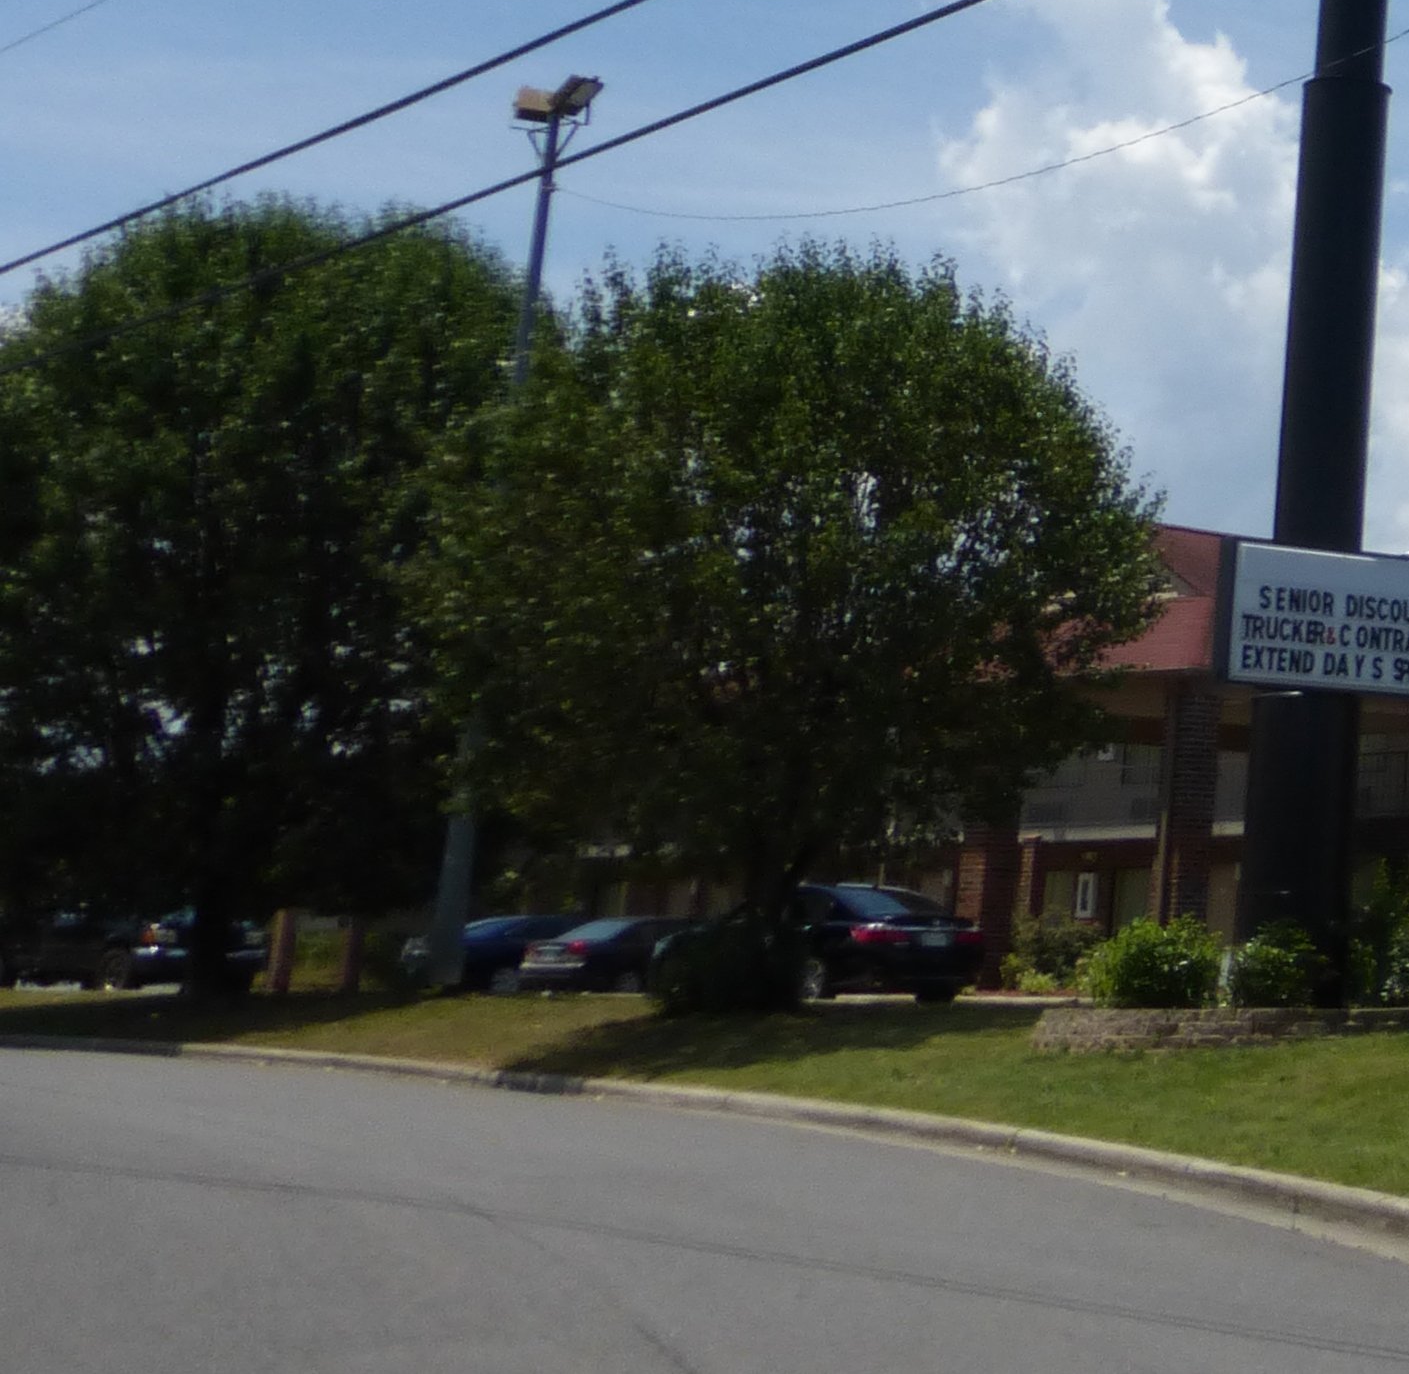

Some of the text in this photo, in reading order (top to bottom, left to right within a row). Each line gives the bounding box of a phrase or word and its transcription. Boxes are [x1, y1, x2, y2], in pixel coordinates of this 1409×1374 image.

[1259, 585, 1334, 617] SENIOR
[1242, 613, 1325, 645] TRUCKER
[1325, 628, 1336, 645] &
[1241, 644, 1315, 676] EXTEND
